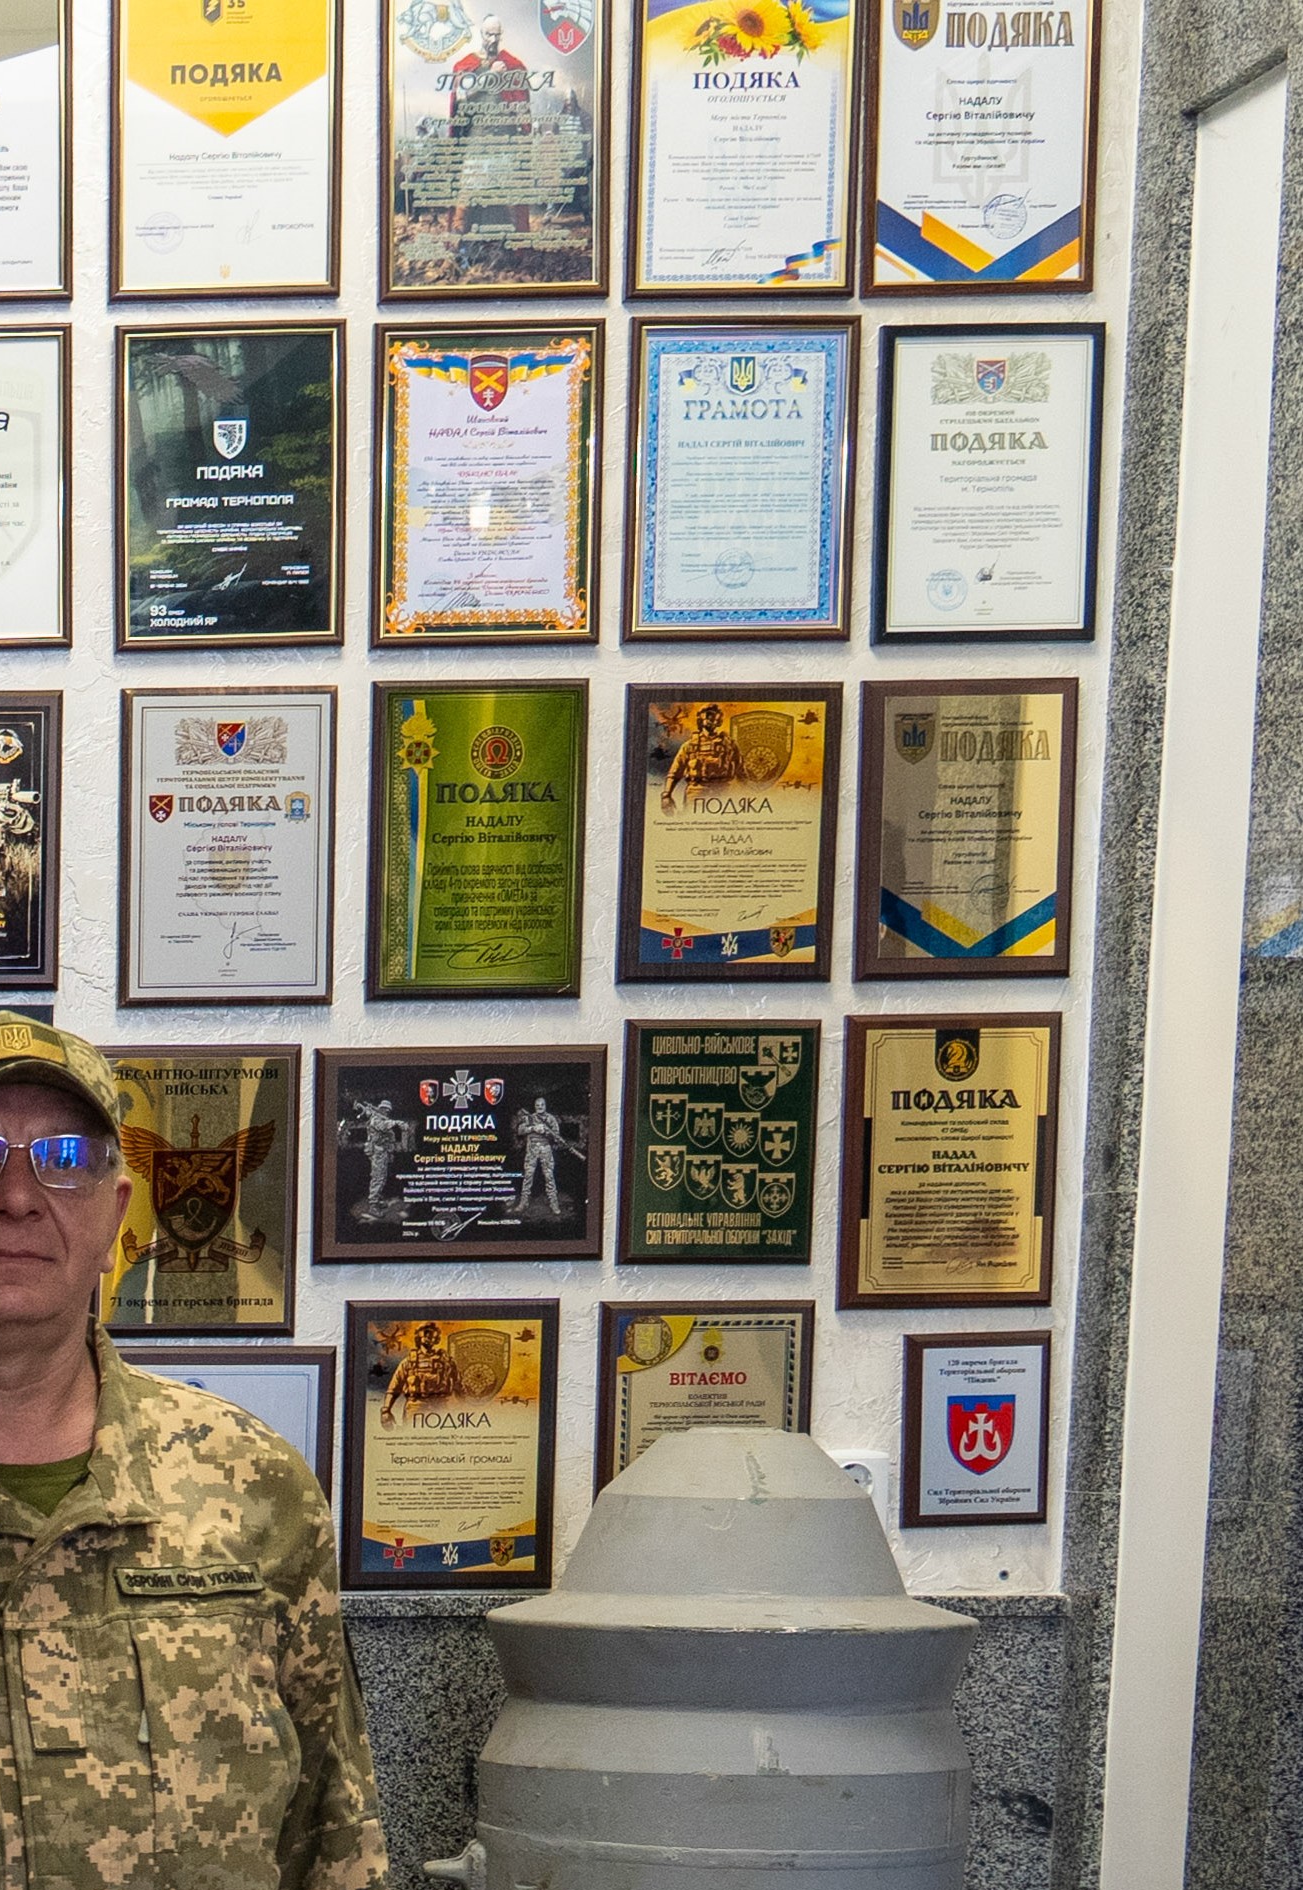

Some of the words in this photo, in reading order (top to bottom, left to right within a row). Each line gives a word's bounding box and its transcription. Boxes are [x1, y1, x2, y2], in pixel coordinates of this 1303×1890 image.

[945, 11, 1074, 50] ПОДЯКА
[170, 62, 282, 87] ПОДЯКА
[435, 70, 556, 92] ПОДЯКА
[693, 71, 800, 90] ПОДЯКА
[683, 399, 803, 422] ГРАМОТА
[930, 433, 1048, 453] ПОДЯКА
[196, 465, 263, 481] ПОДЯКА
[166, 496, 218, 508] ГРОМАДІ
[222, 495, 293, 508] ТЕРНОПОЛЯ
[150, 617, 204, 628] ХОЛОДНИЙ
[206, 616, 218, 626] ЯР
[940, 729, 1051, 765] ПОДЯКА
[436, 783, 558, 805] ПОДЯКА
[178, 795, 282, 814] ПОДЯКА
[693, 797, 773, 816] ПОДЯКА
[466, 815, 523, 828] НАДАЛУ
[432, 833, 475, 845] Сергію
[478, 832, 557, 845] Віталійовичу
[652, 1035, 756, 1055] ЦИВІЛЬНО-ВІЙСЬКОВЕ
[113, 1068, 279, 1083] ДЕСАНТНО-ШТУРМОВІ
[651, 1066, 738, 1085] СПІВРОБІТНИЦТВО
[164, 1083, 229, 1097] ВІЙСЬКА
[890, 1089, 1021, 1113] ПОДЯКА
[425, 1115, 495, 1132] ПОДЯКА
[440, 1144, 480, 1153] НАДАЛУ
[932, 1150, 976, 1160] НАДАЛ
[669, 1371, 747, 1387] ВІТАЄМО
[413, 1412, 492, 1431] ПОДЯКА
[125, 1573, 173, 1589] ЗБРОЙНІ
[177, 1573, 204, 1588] СИЛИ
[207, 1569, 256, 1587] УКРАЇНИ
